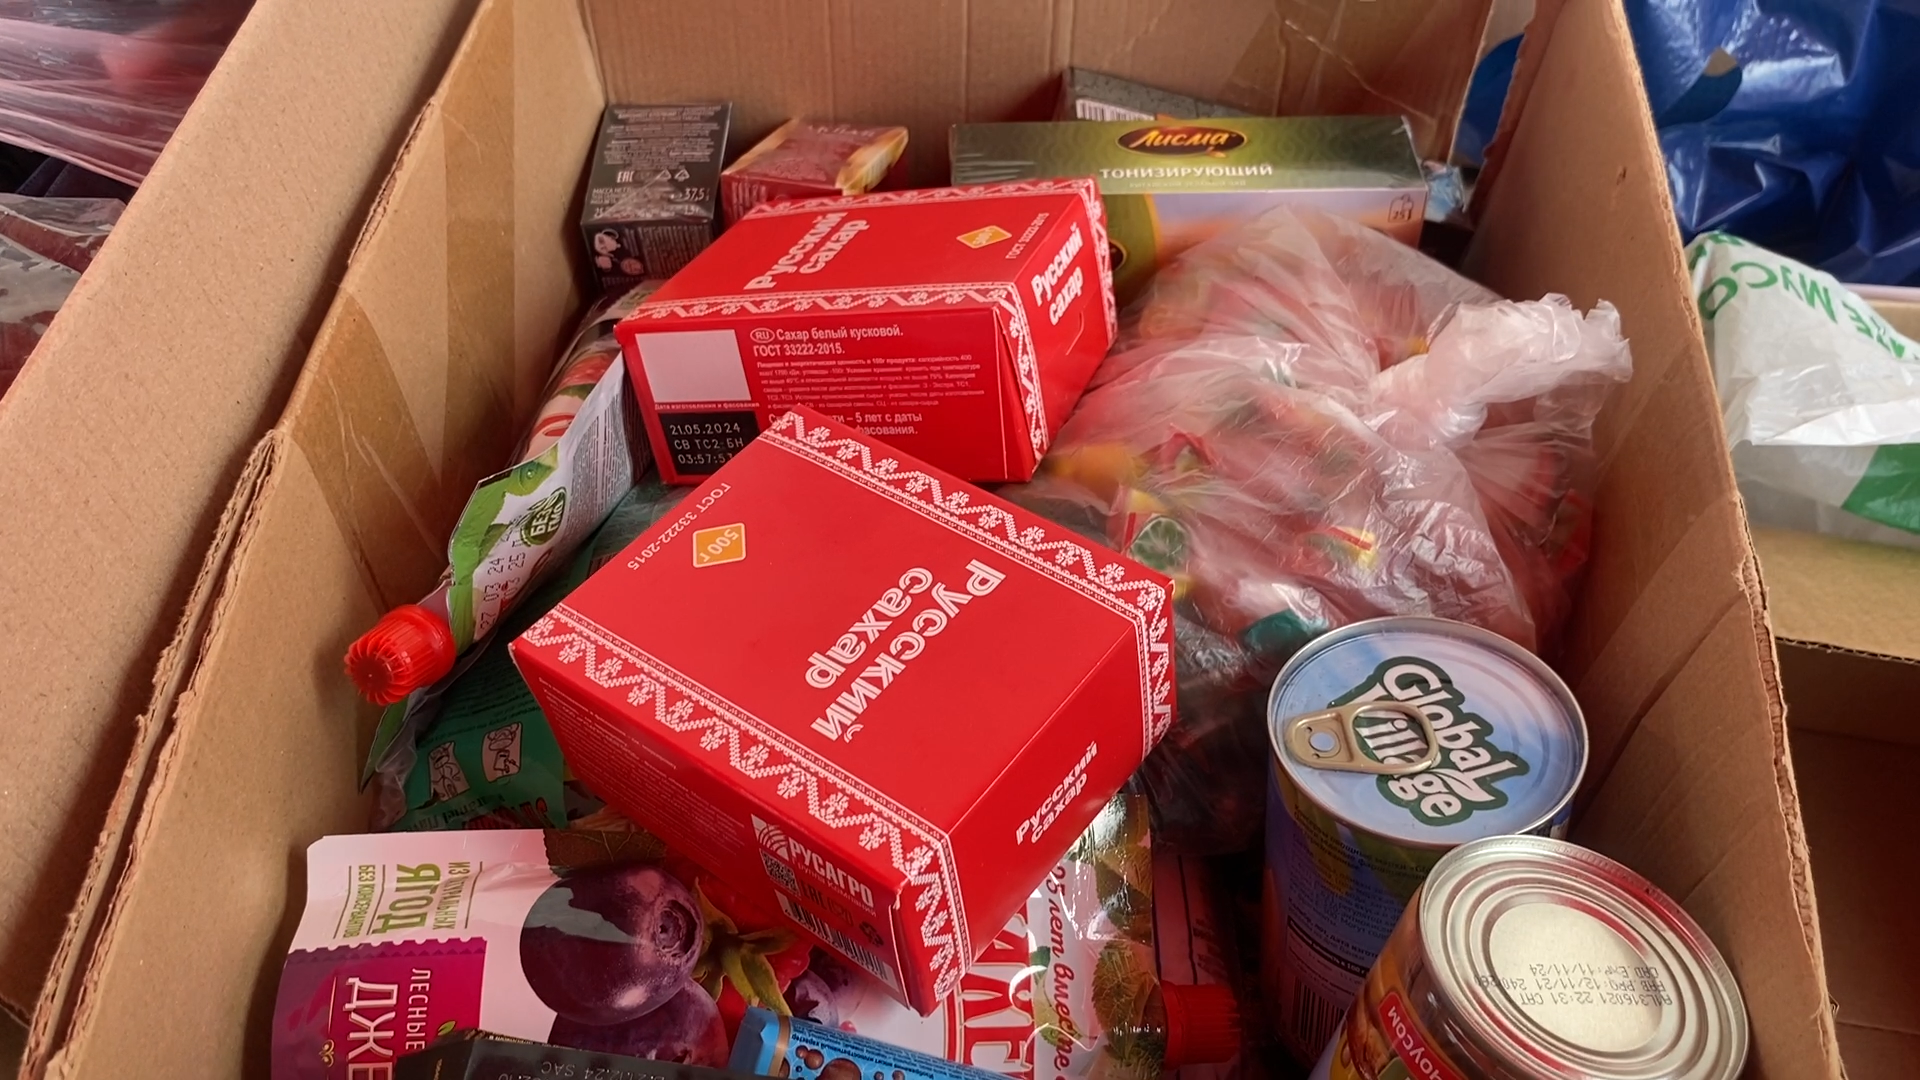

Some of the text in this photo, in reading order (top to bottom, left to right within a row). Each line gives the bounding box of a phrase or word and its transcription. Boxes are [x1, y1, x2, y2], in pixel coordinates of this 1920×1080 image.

[1128, 130, 1230, 148] Лисма
[1099, 162, 1273, 179] ТОНИЗИРУЮЩИЙ
[743, 212, 848, 291] Русский
[799, 219, 870, 274] сахар
[1031, 221, 1084, 306] Русский
[1049, 266, 1084, 326] сахар
[753, 342, 846, 357] ГОСТ 33222-2015.
[755, 324, 904, 343] RU Сахар белый кусковой.
[655, 403, 670, 411] Дата
[722, 402, 760, 410] фасования
[669, 422, 741, 436] 21.05.2024
[855, 413, 863, 423] 5
[865, 415, 883, 423] лет
[885, 415, 892, 423] с
[894, 413, 923, 426] даты
[530, 507, 550, 537] БЕЗ
[547, 502, 564, 533] ГМО
[627, 482, 732, 571] ГОСТ 33222-2015
[487, 557, 505, 576] 24
[699, 528, 740, 563] 500 г
[804, 567, 934, 689] сахар
[810, 558, 1006, 744] Русский
[1382, 663, 1518, 782] Global
[1015, 740, 1098, 845] Русский
[1031, 773, 1088, 844] сахар
[448, 861, 471, 875] ИЗ
[788, 837, 875, 909] РУСАГРО
[343, 864, 376, 938] БЕЗ КОНСЕРВАНТОВ
[371, 863, 442, 935] ЯГОД
[1049, 898, 1065, 959] лет
[405, 968, 432, 1050] ЛЕСНЫЕ
[1053, 962, 1075, 1071] вместе
[1519, 992, 1544, 1007] CAT
[1550, 991, 1594, 1006] 22:31
[541, 1061, 576, 1077] SAC
